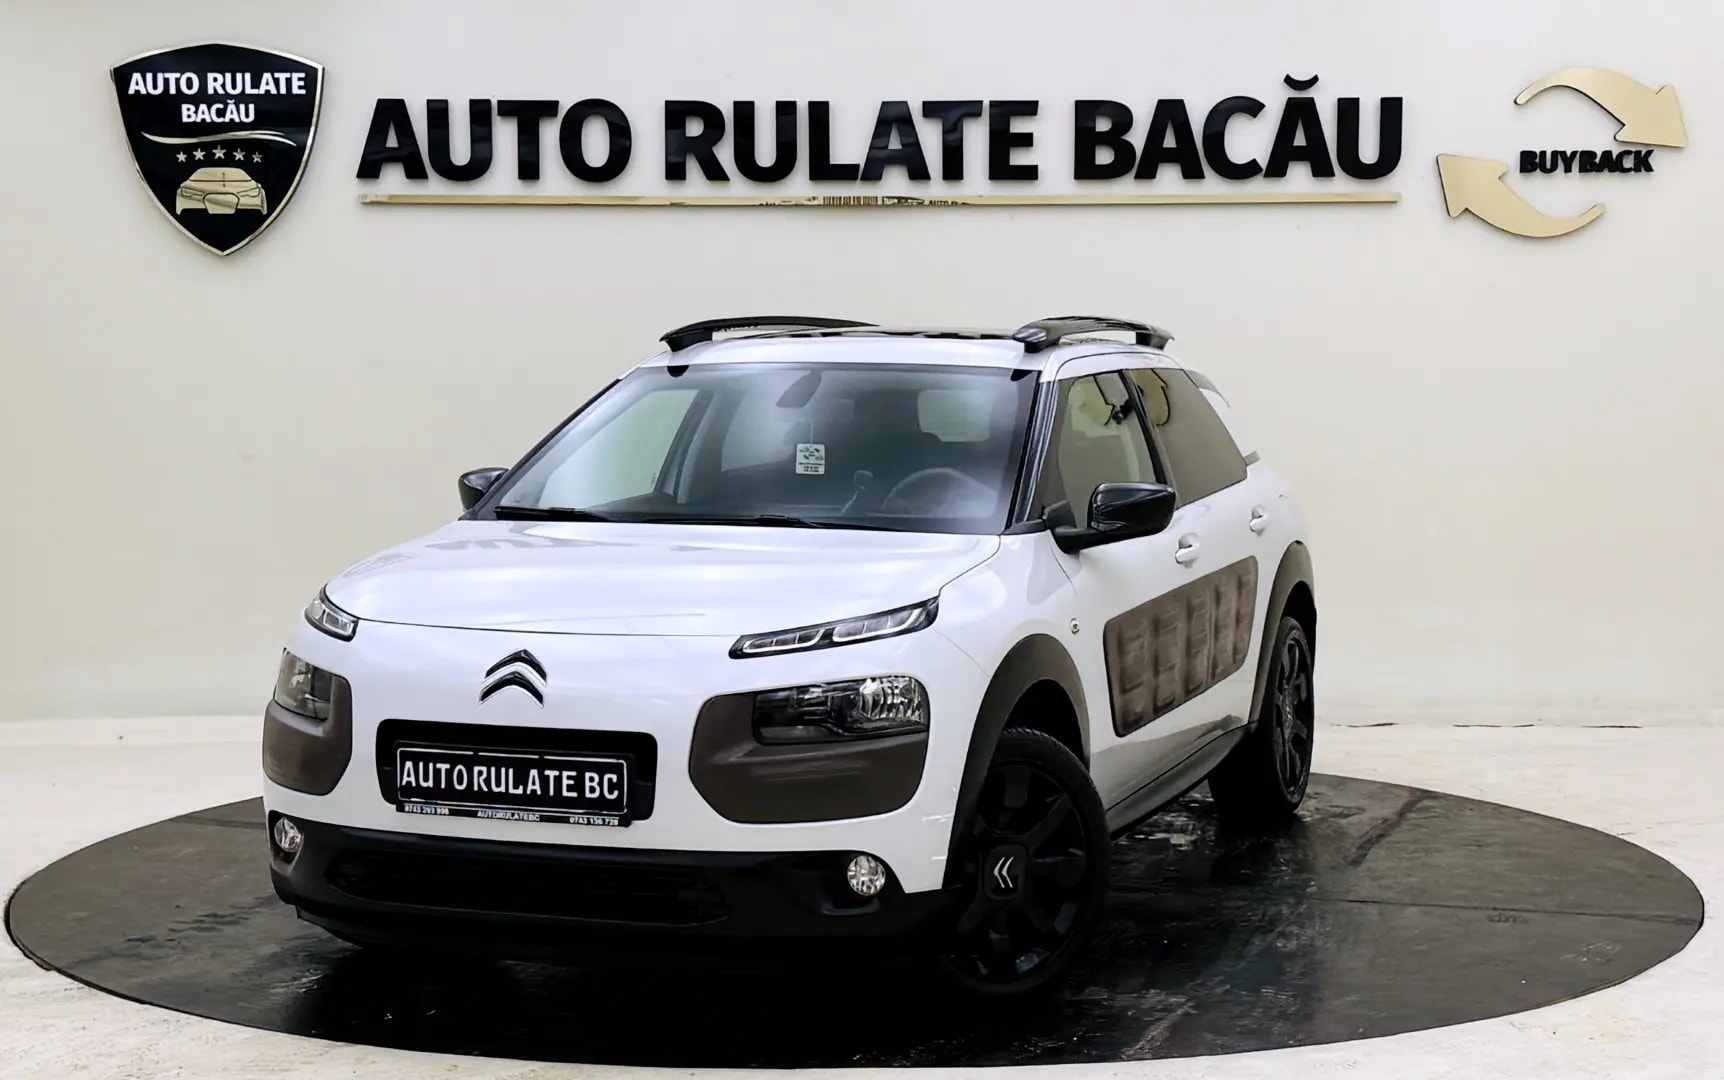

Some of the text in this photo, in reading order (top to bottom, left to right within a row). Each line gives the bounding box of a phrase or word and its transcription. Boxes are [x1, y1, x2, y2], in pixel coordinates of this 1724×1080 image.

[127, 72, 306, 95] AUTO RULATE
[181, 99, 255, 123] BACĂU
[356, 74, 1404, 182] AUTO RULATE BACĂU
[1519, 150, 1655, 173] BUYBACK
[401, 761, 619, 800] AUTO RULATE BC
